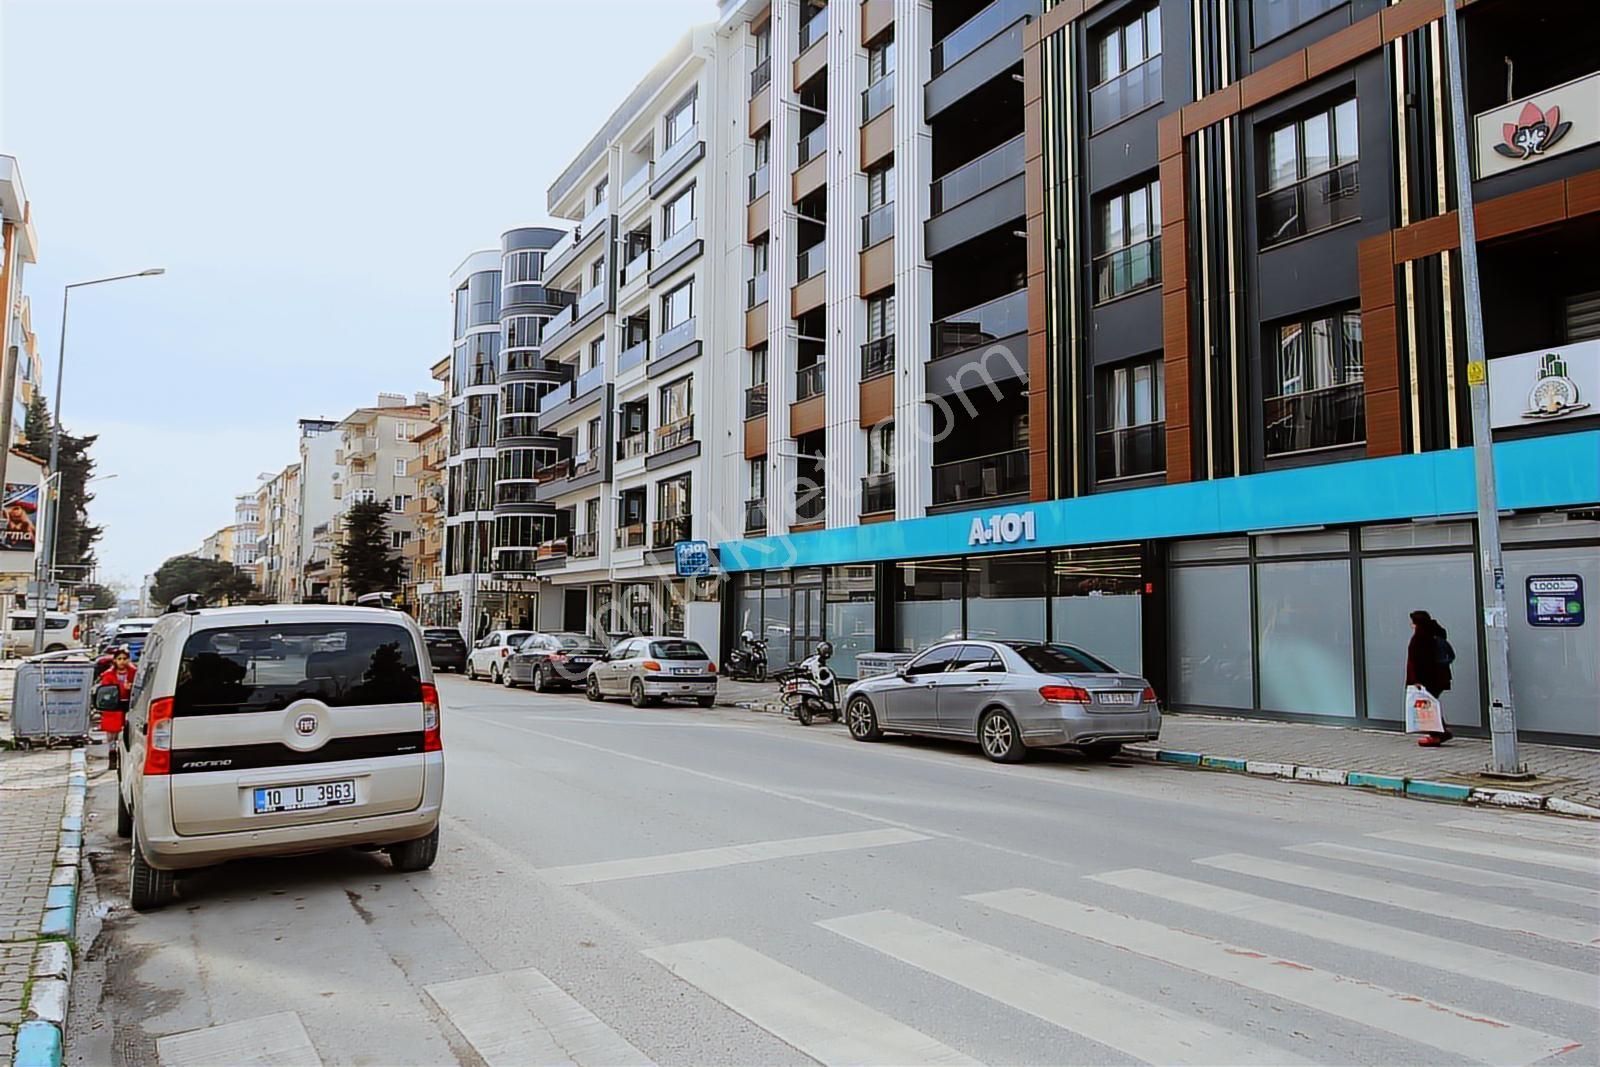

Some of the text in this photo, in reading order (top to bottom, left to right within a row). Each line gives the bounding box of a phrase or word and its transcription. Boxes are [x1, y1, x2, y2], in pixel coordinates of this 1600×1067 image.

[267, 790, 281, 806] 10
[296, 788, 304, 803] U
[317, 783, 351, 801] 3963
